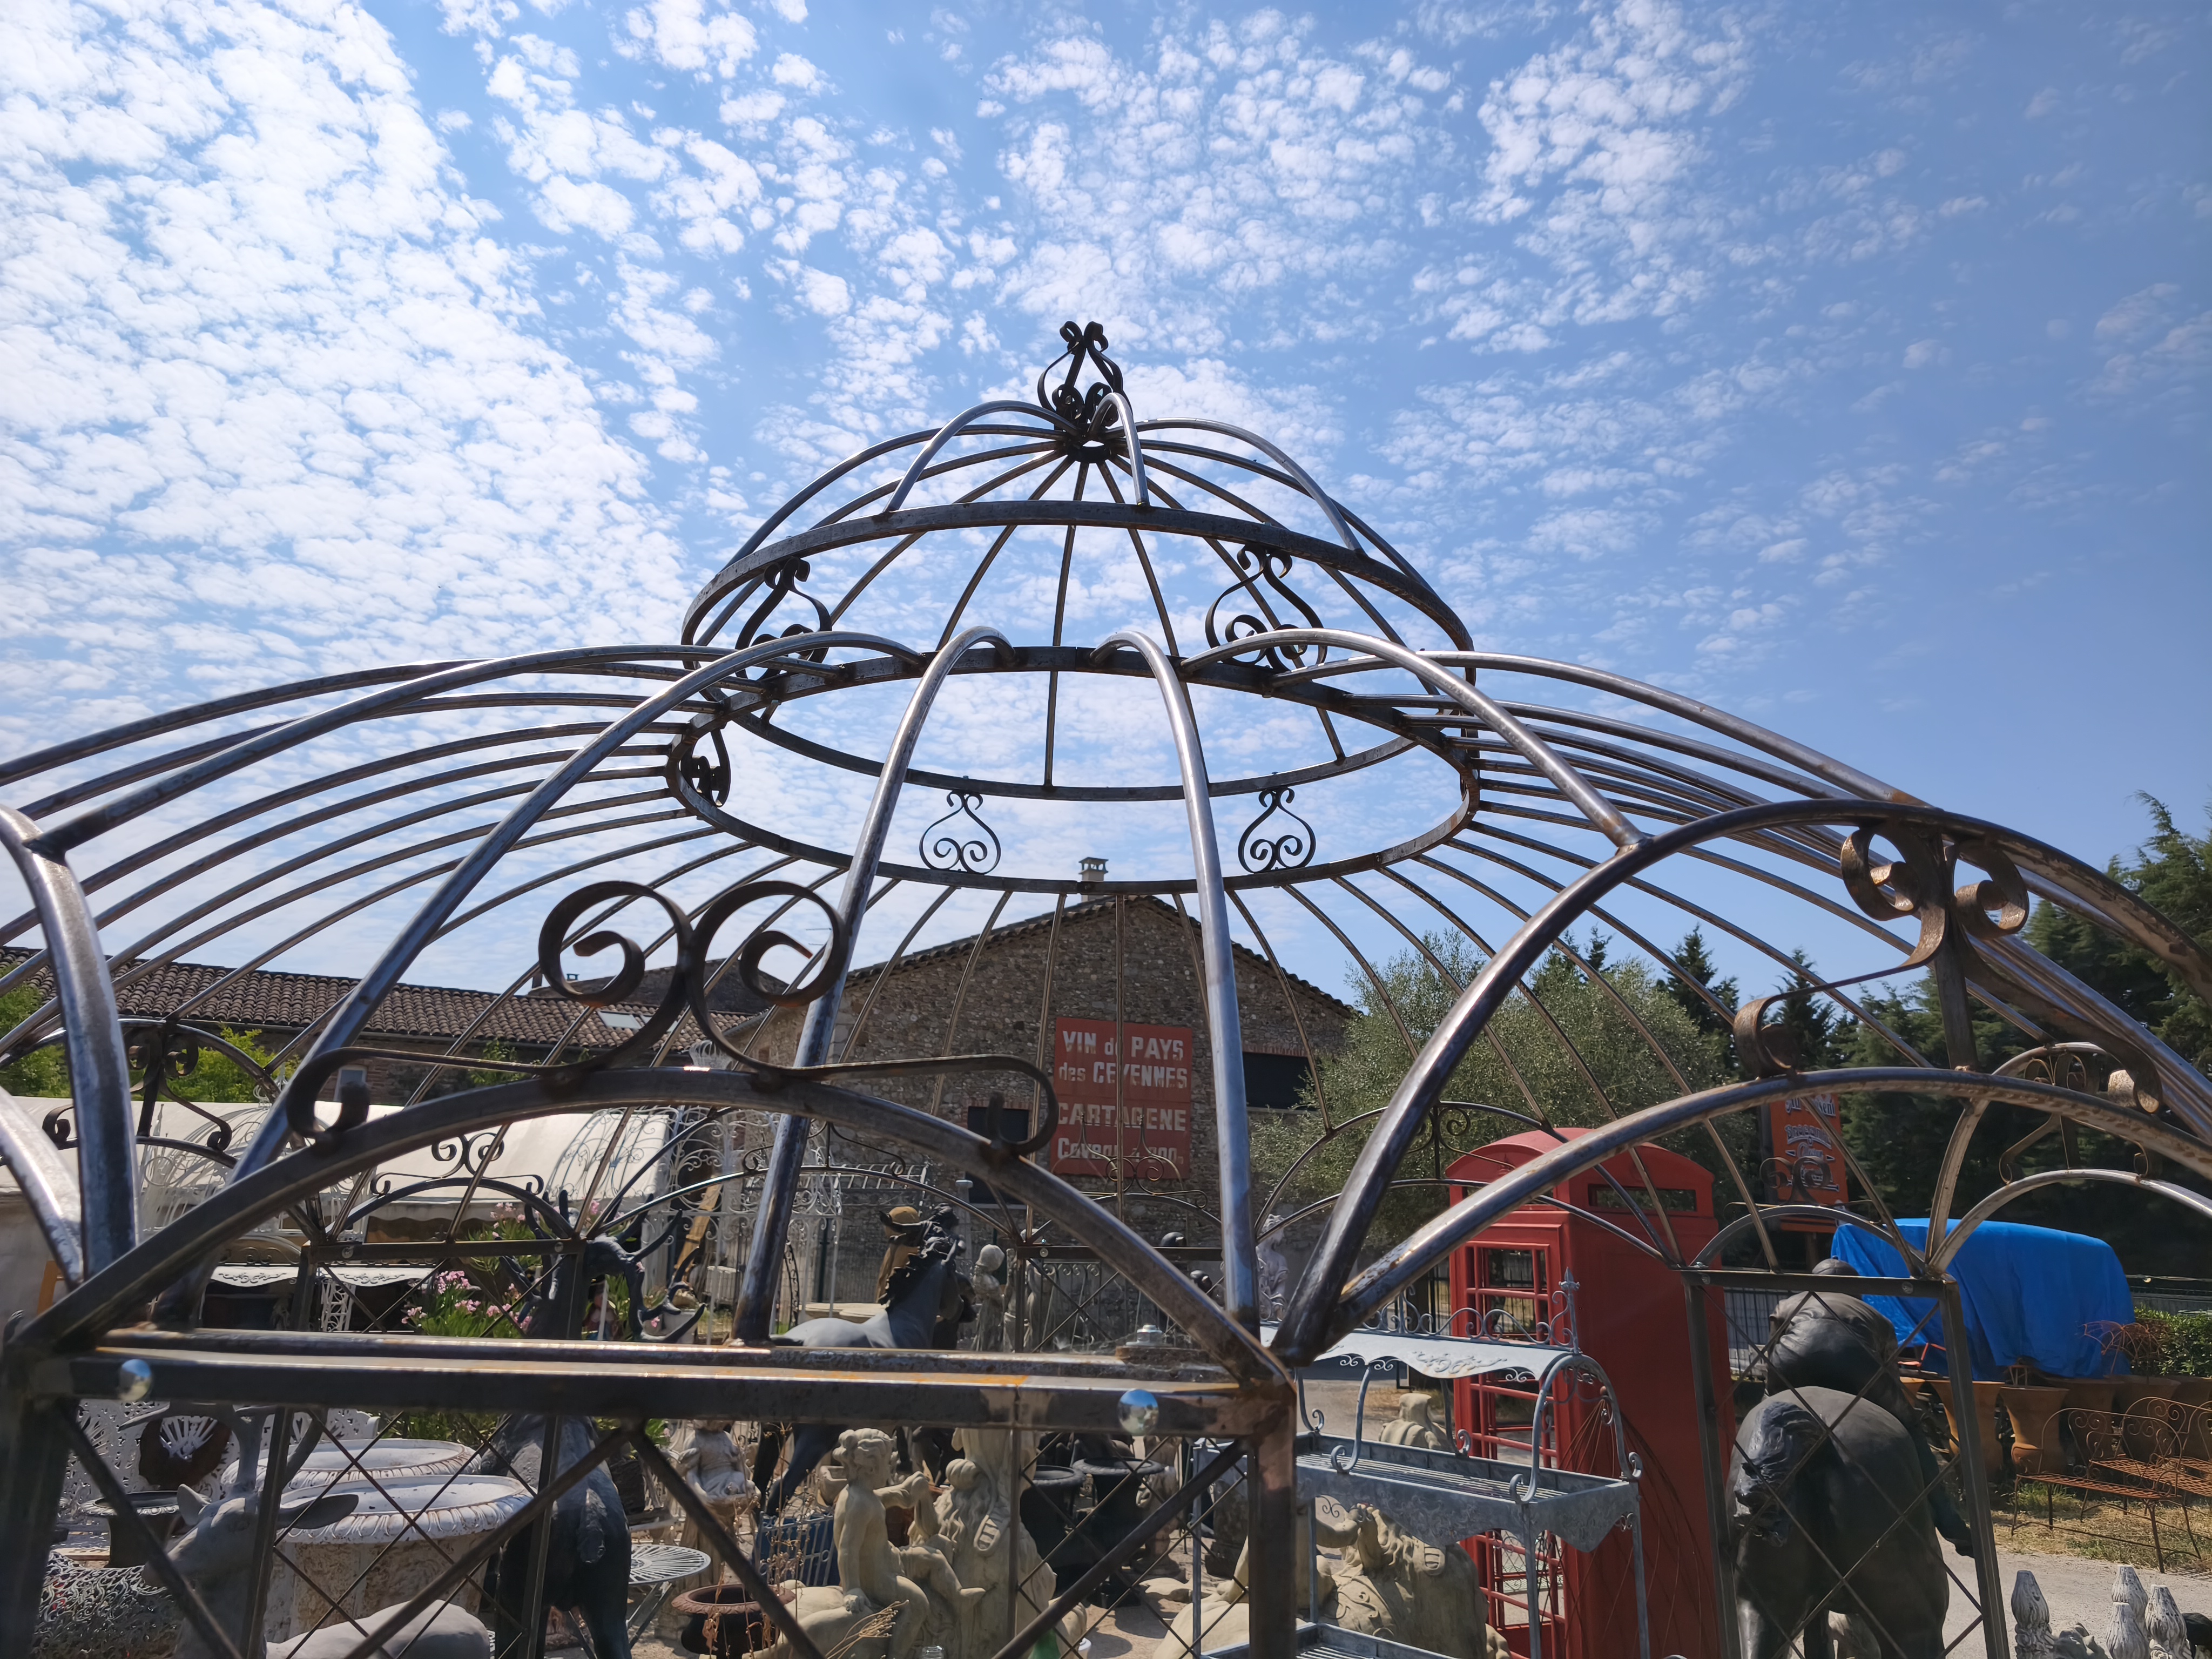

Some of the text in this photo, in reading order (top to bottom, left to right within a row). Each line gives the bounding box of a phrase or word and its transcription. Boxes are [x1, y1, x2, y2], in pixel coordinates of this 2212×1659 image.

[1062, 1030, 1097, 1054] VIN
[1131, 1036, 1184, 1061] PAYS
[1058, 1062, 1086, 1082] des
[1057, 1102, 1186, 1131] CARTAGENE
